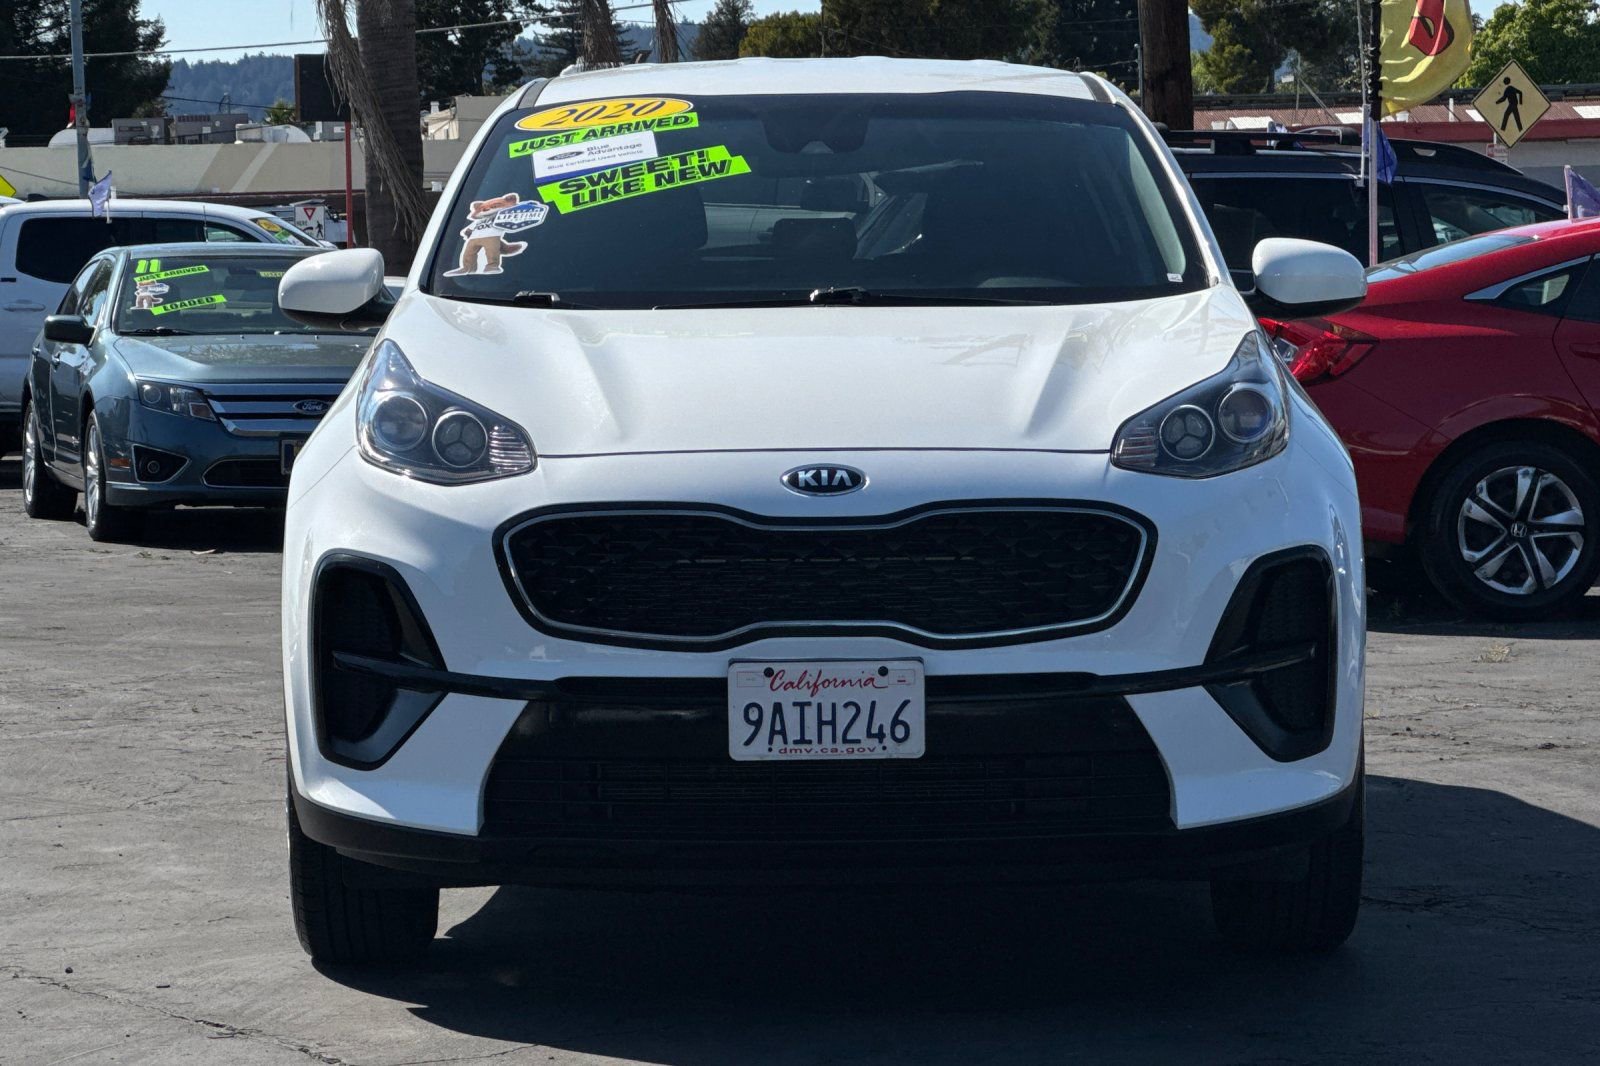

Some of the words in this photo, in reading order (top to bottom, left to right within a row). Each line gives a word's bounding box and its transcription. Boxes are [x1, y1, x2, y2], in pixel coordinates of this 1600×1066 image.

[542, 100, 667, 127] 2020
[514, 132, 580, 154] JUST
[581, 114, 695, 140] ARRIVED
[587, 143, 610, 151] Blue
[587, 143, 643, 156] Advantage
[565, 157, 596, 167] Certified
[558, 149, 710, 195] SWEET!
[571, 177, 646, 208] LIKE
[653, 159, 733, 188] NEW
[497, 212, 543, 220] LIFETIME
[164, 266, 206, 277] ARRIVED
[162, 296, 216, 311] LOADED
[797, 469, 853, 487] KIA
[769, 669, 889, 697] California
[743, 699, 911, 746] 9AIH246
[778, 746, 877, 755] dmv.ca.gov
